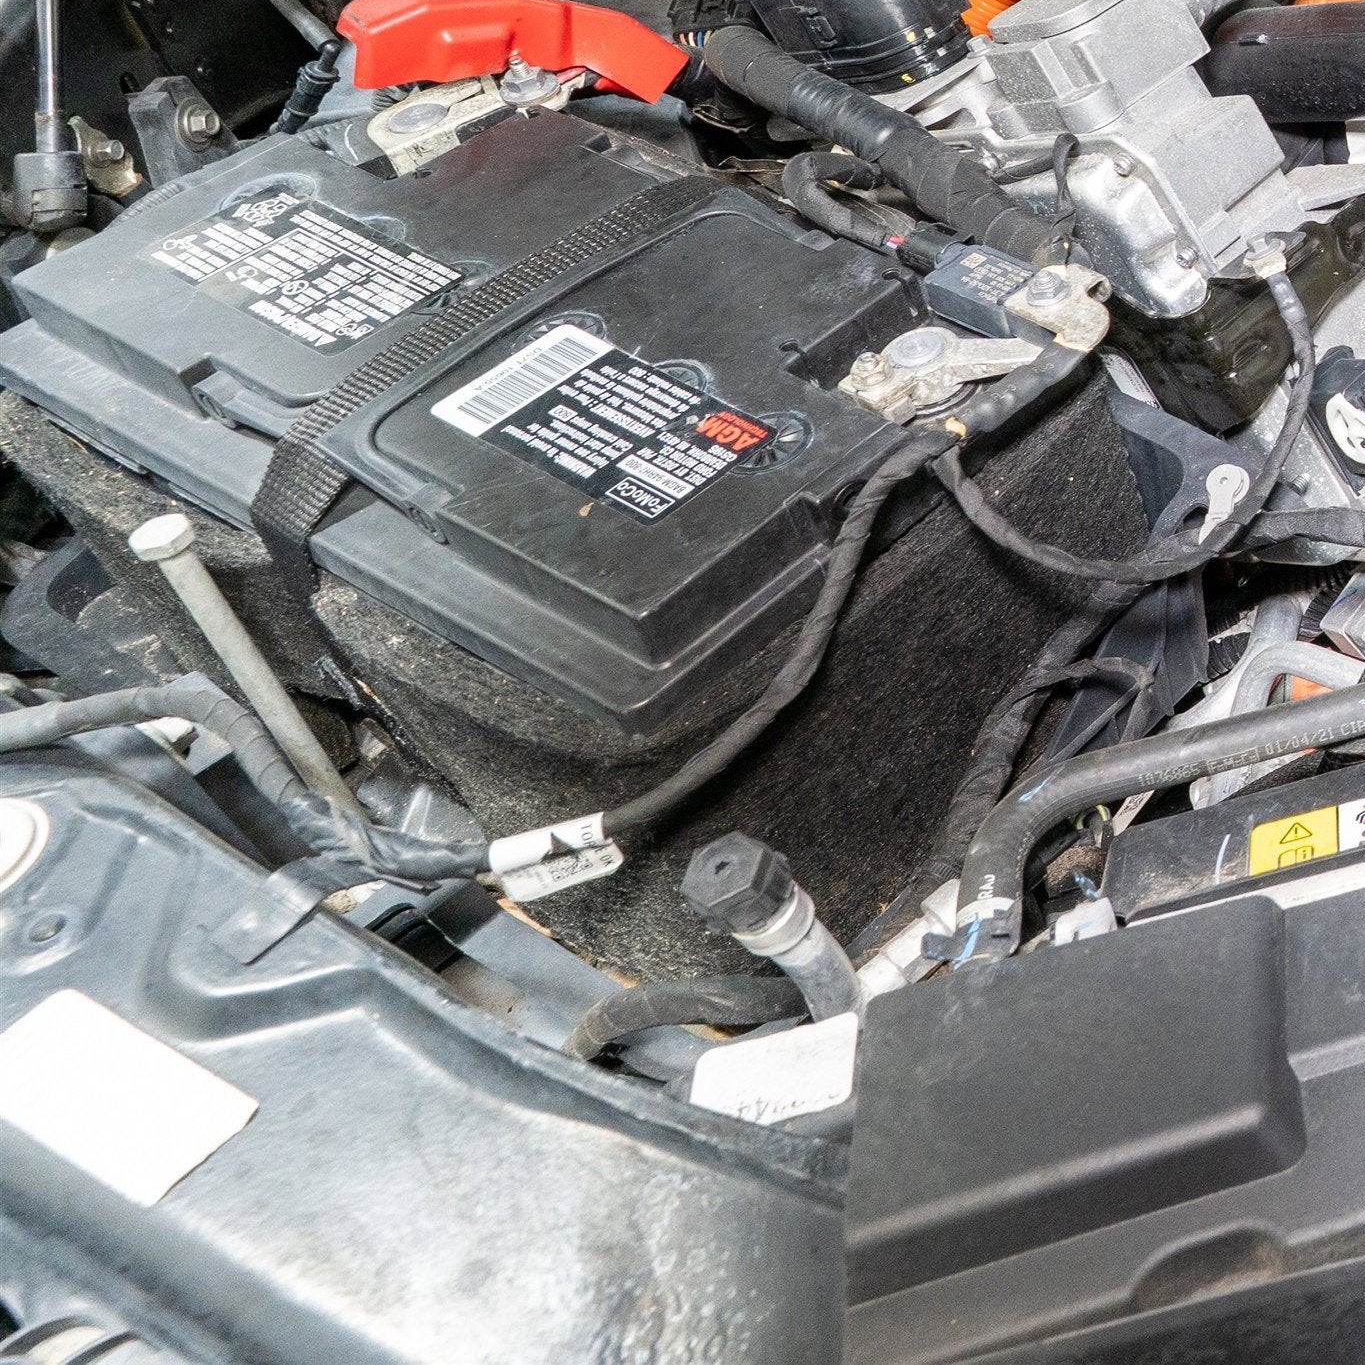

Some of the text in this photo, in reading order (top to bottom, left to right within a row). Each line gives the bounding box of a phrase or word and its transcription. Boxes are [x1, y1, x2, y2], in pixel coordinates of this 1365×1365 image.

[588, 402, 656, 438] AVERTISSEMENT
[715, 409, 769, 438] TECHNOLOGY
[610, 438, 634, 452] Cold
[693, 415, 760, 453] AGM
[549, 451, 598, 478] WARNING:
[636, 445, 659, 459] PAR
[656, 444, 718, 478] FORD MOTOR CO.
[672, 465, 690, 476] BY
[683, 470, 707, 485] DIST.
[616, 481, 669, 512] FoMoCo
[1265, 728, 1335, 756] 01/04/21
[600, 854, 616, 867] OK
